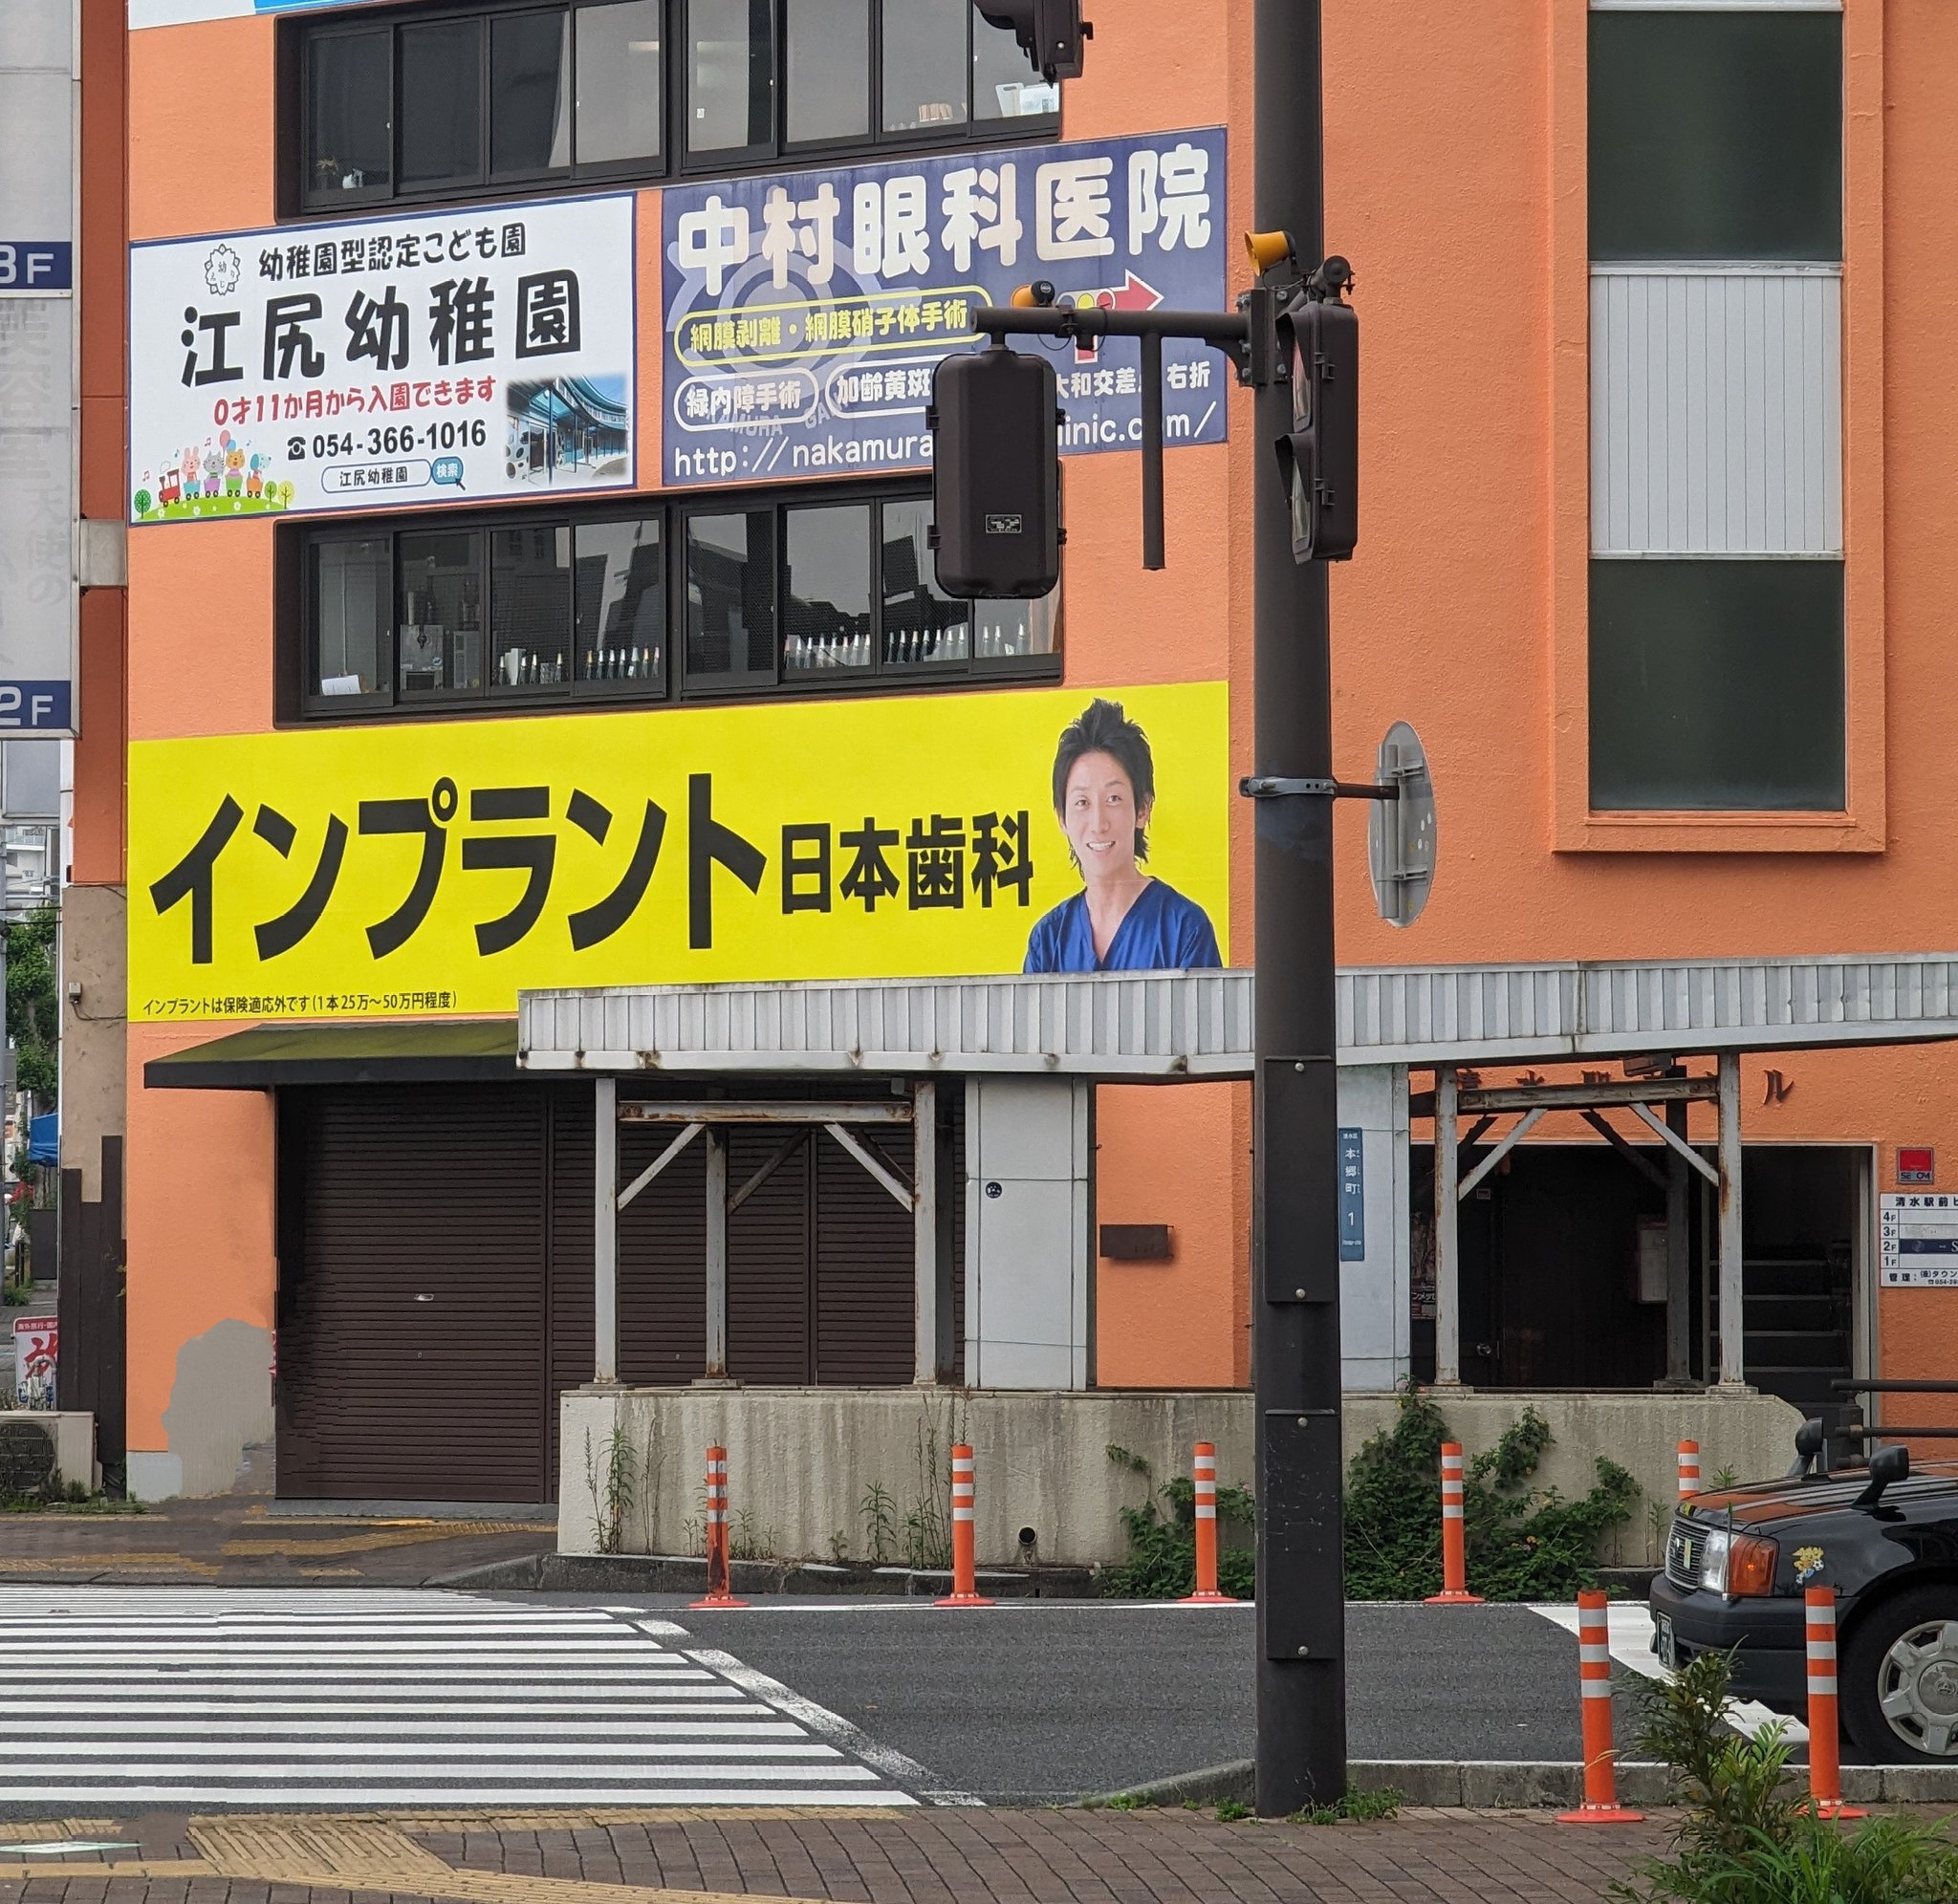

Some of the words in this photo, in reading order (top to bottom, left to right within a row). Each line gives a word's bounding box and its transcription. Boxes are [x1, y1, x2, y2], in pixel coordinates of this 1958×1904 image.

[677, 142, 1211, 296] 中村眼科医院
[259, 222, 526, 281] 幼稚園型認定こども園
[181, 269, 581, 387] 江尻幼稚園
[686, 380, 801, 419] 緑内障手術
[837, 367, 934, 405] 加齢黄斑
[1056, 367, 1142, 400] 大和交差
[1166, 360, 1211, 390] 右折
[213, 375, 496, 425] 0才11か月から入園できます
[313, 419, 487, 458] 054-366-1016
[338, 465, 408, 488] 江尻幼稚園
[435, 462, 460, 478] 検索
[149, 772, 767, 964] インプラント
[780, 811, 1034, 916] 日本歯科
[1882, 1211, 1897, 1222] 4F
[1882, 1225, 1897, 1237] 3F
[1883, 1241, 1897, 1251] 2F
